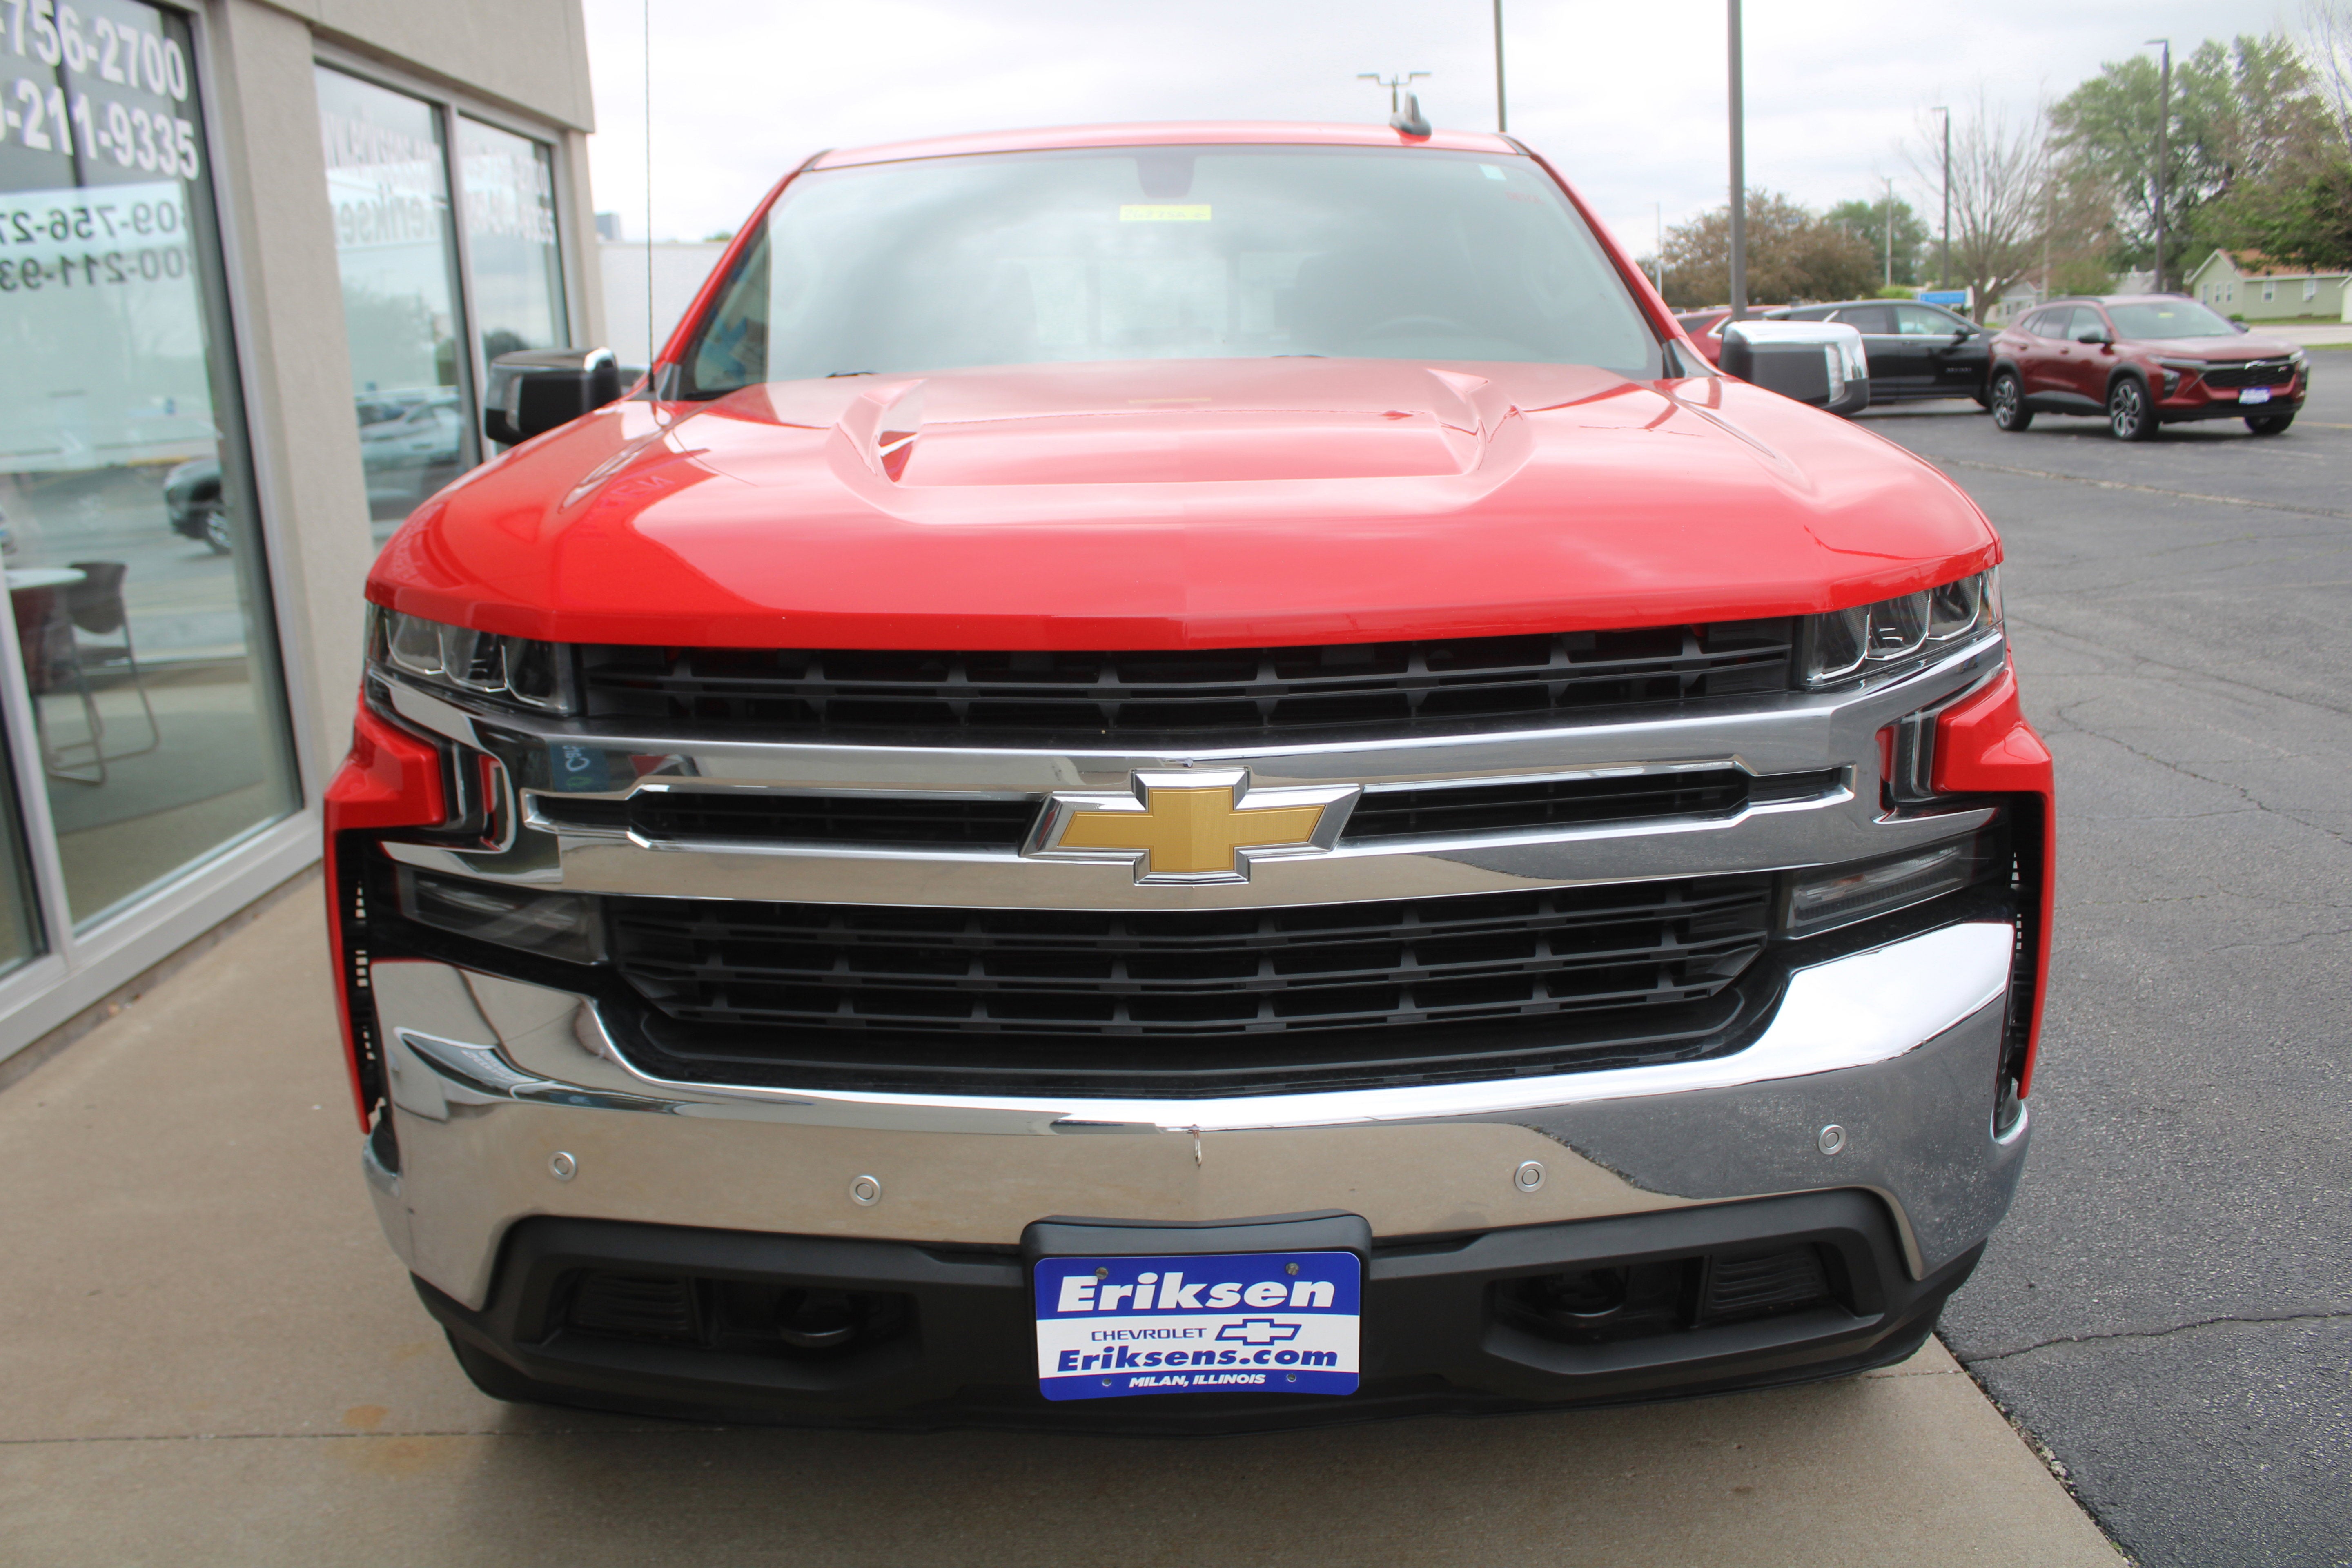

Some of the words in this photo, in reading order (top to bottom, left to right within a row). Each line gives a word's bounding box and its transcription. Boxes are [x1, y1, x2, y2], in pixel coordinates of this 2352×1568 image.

[0, 78, 199, 180] -211-9335
[1057, 1272, 1335, 1312] Eriksen
[1091, 1327, 1207, 1341] CHEVROLET
[1057, 1345, 1338, 1372] Eriksens.com
[1129, 1375, 1189, 1388] MILAN,
[1192, 1374, 1266, 1385] ILLINOIS
